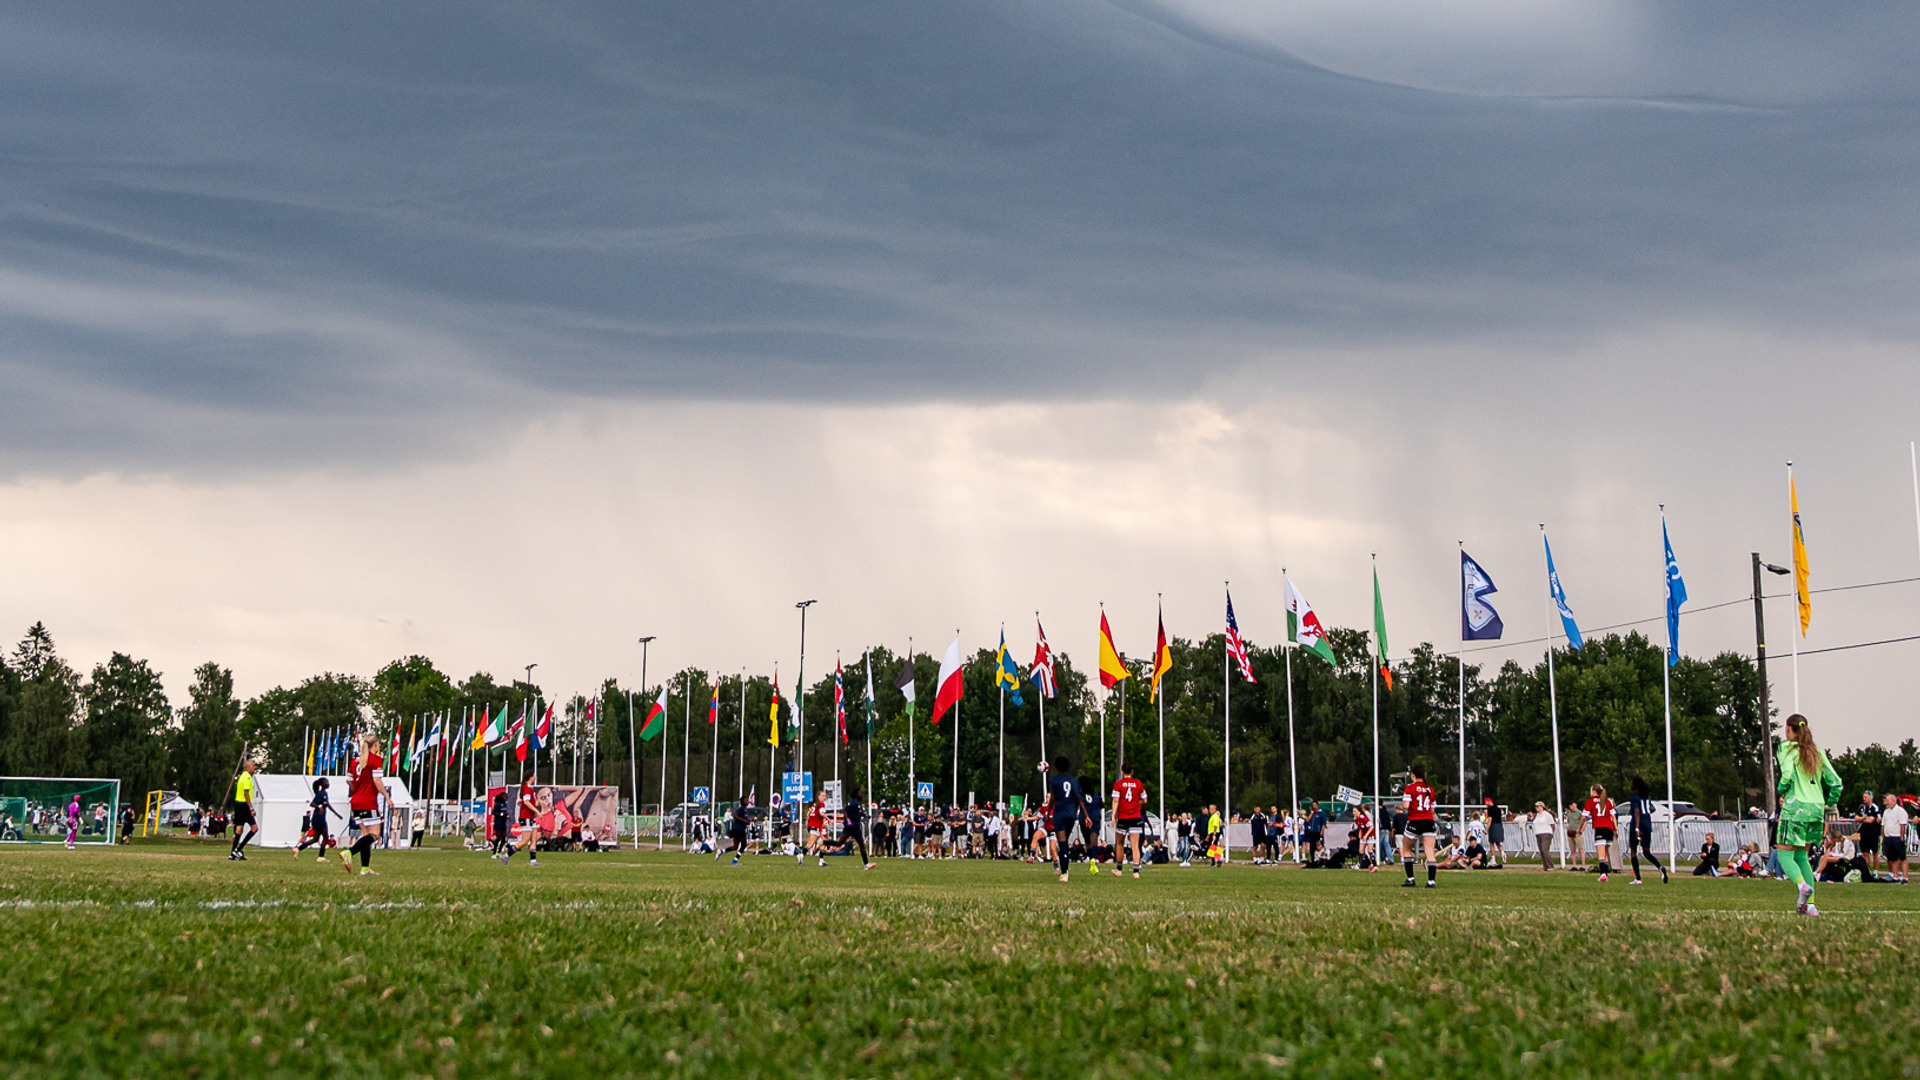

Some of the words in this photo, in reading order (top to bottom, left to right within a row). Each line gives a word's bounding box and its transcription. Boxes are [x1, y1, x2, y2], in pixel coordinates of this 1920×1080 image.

[1063, 781, 1071, 798] 9
[1125, 787, 1133, 802] 4
[1416, 794, 1431, 811] 14
